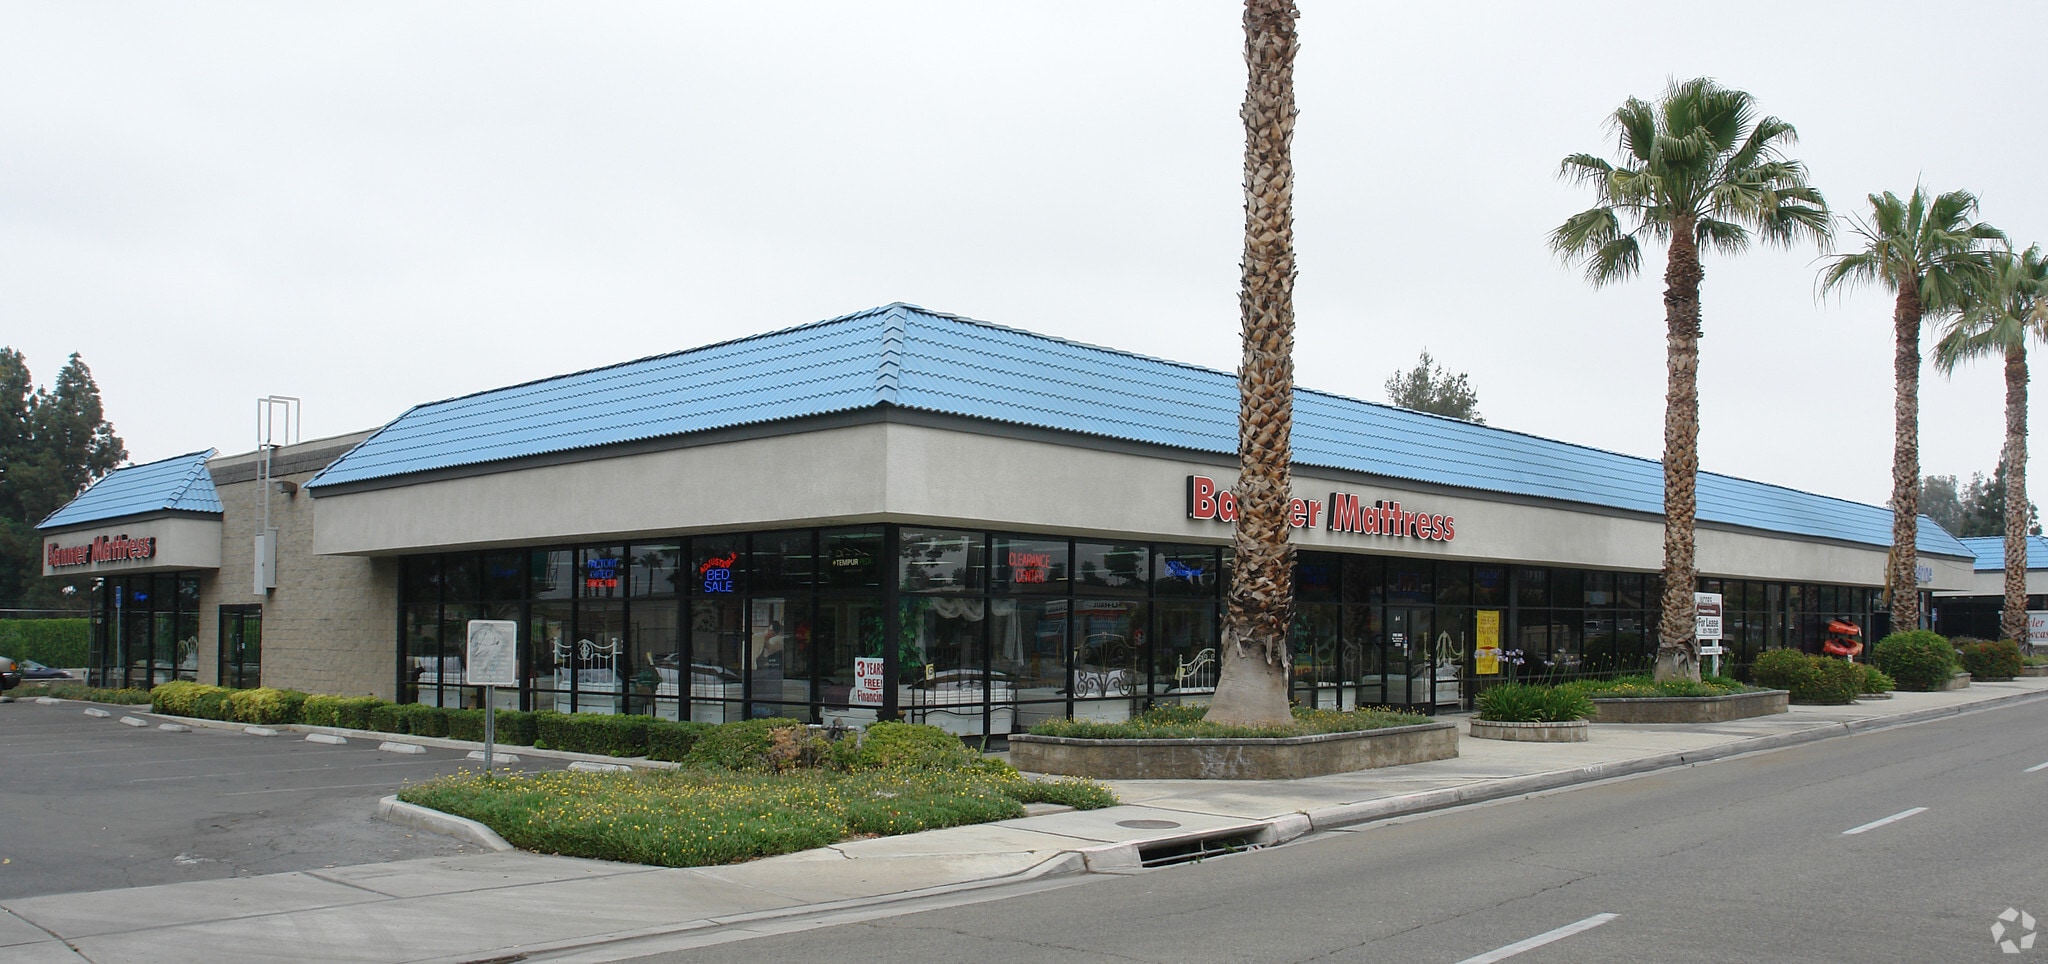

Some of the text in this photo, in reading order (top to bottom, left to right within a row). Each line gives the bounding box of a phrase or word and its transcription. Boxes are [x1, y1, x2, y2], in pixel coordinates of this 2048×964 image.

[1192, 475, 1457, 543] Baer Mattress
[47, 534, 153, 567] Banner Mattress
[588, 559, 617, 568] FACTORY
[700, 551, 737, 574] ADJUSTABLE
[1009, 552, 1050, 568] CLEARANCE
[707, 568, 730, 581] BED
[1016, 569, 1045, 583] CENTER
[704, 581, 733, 592] SALE
[1706, 617, 1719, 628] Lease
[857, 661, 885, 678] 3 YEARS
[864, 678, 883, 688] FREE!
[857, 689, 884, 703] Financin
